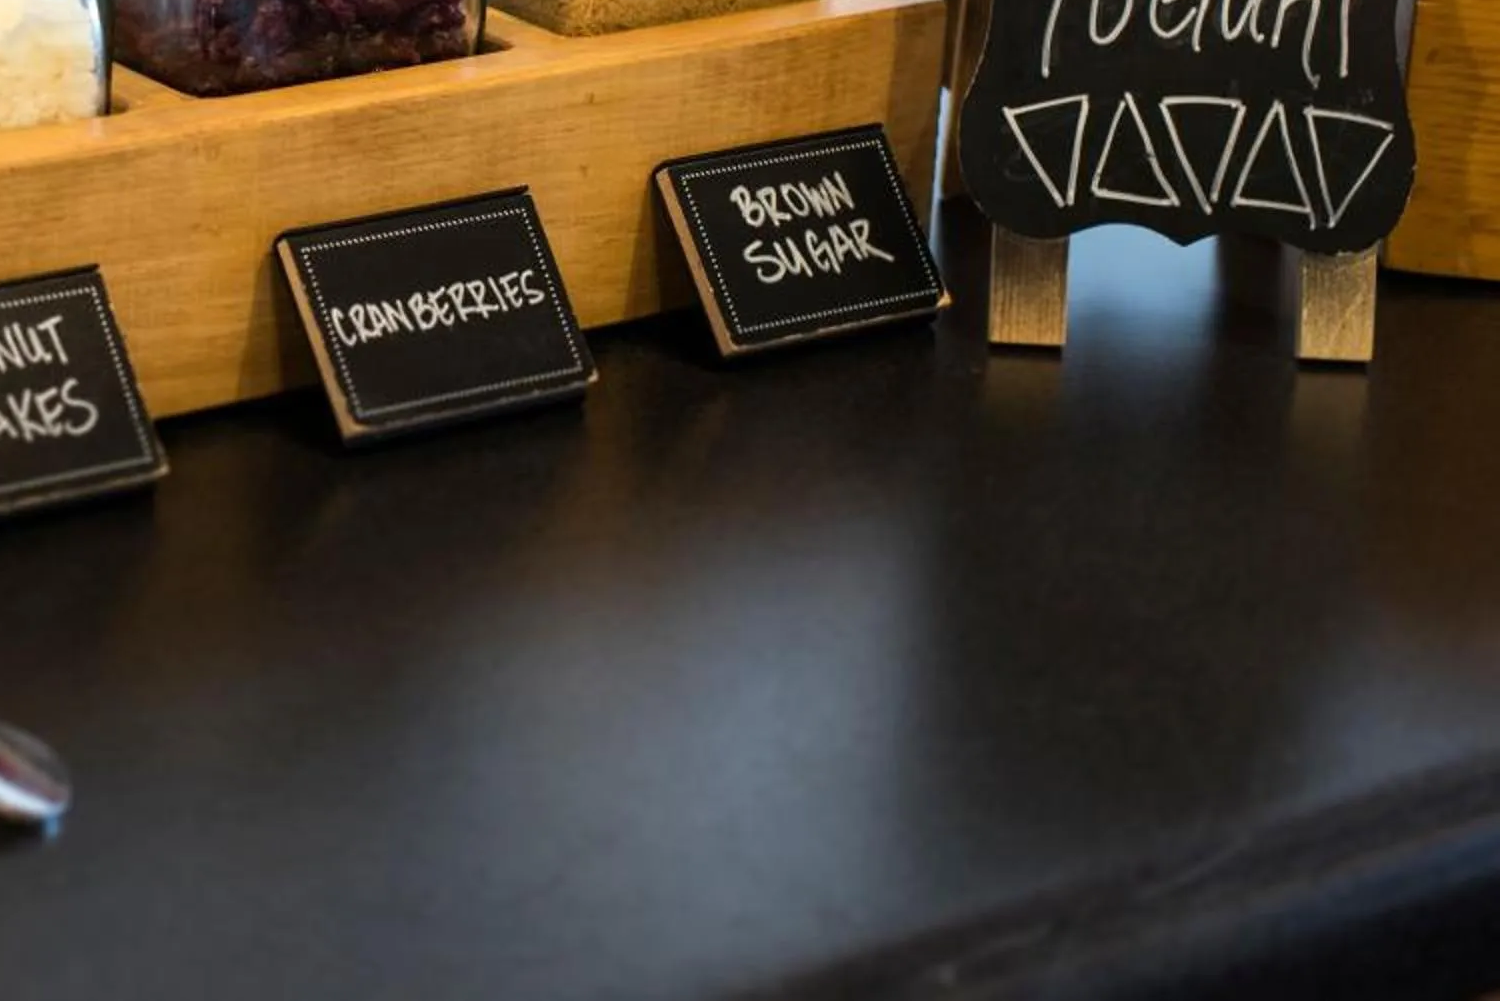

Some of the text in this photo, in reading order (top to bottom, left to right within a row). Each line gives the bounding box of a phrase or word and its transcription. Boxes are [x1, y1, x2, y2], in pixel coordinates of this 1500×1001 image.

[729, 170, 855, 228] BROWN
[743, 218, 895, 285] SUGAR
[331, 269, 546, 347] CRANBERRIES
